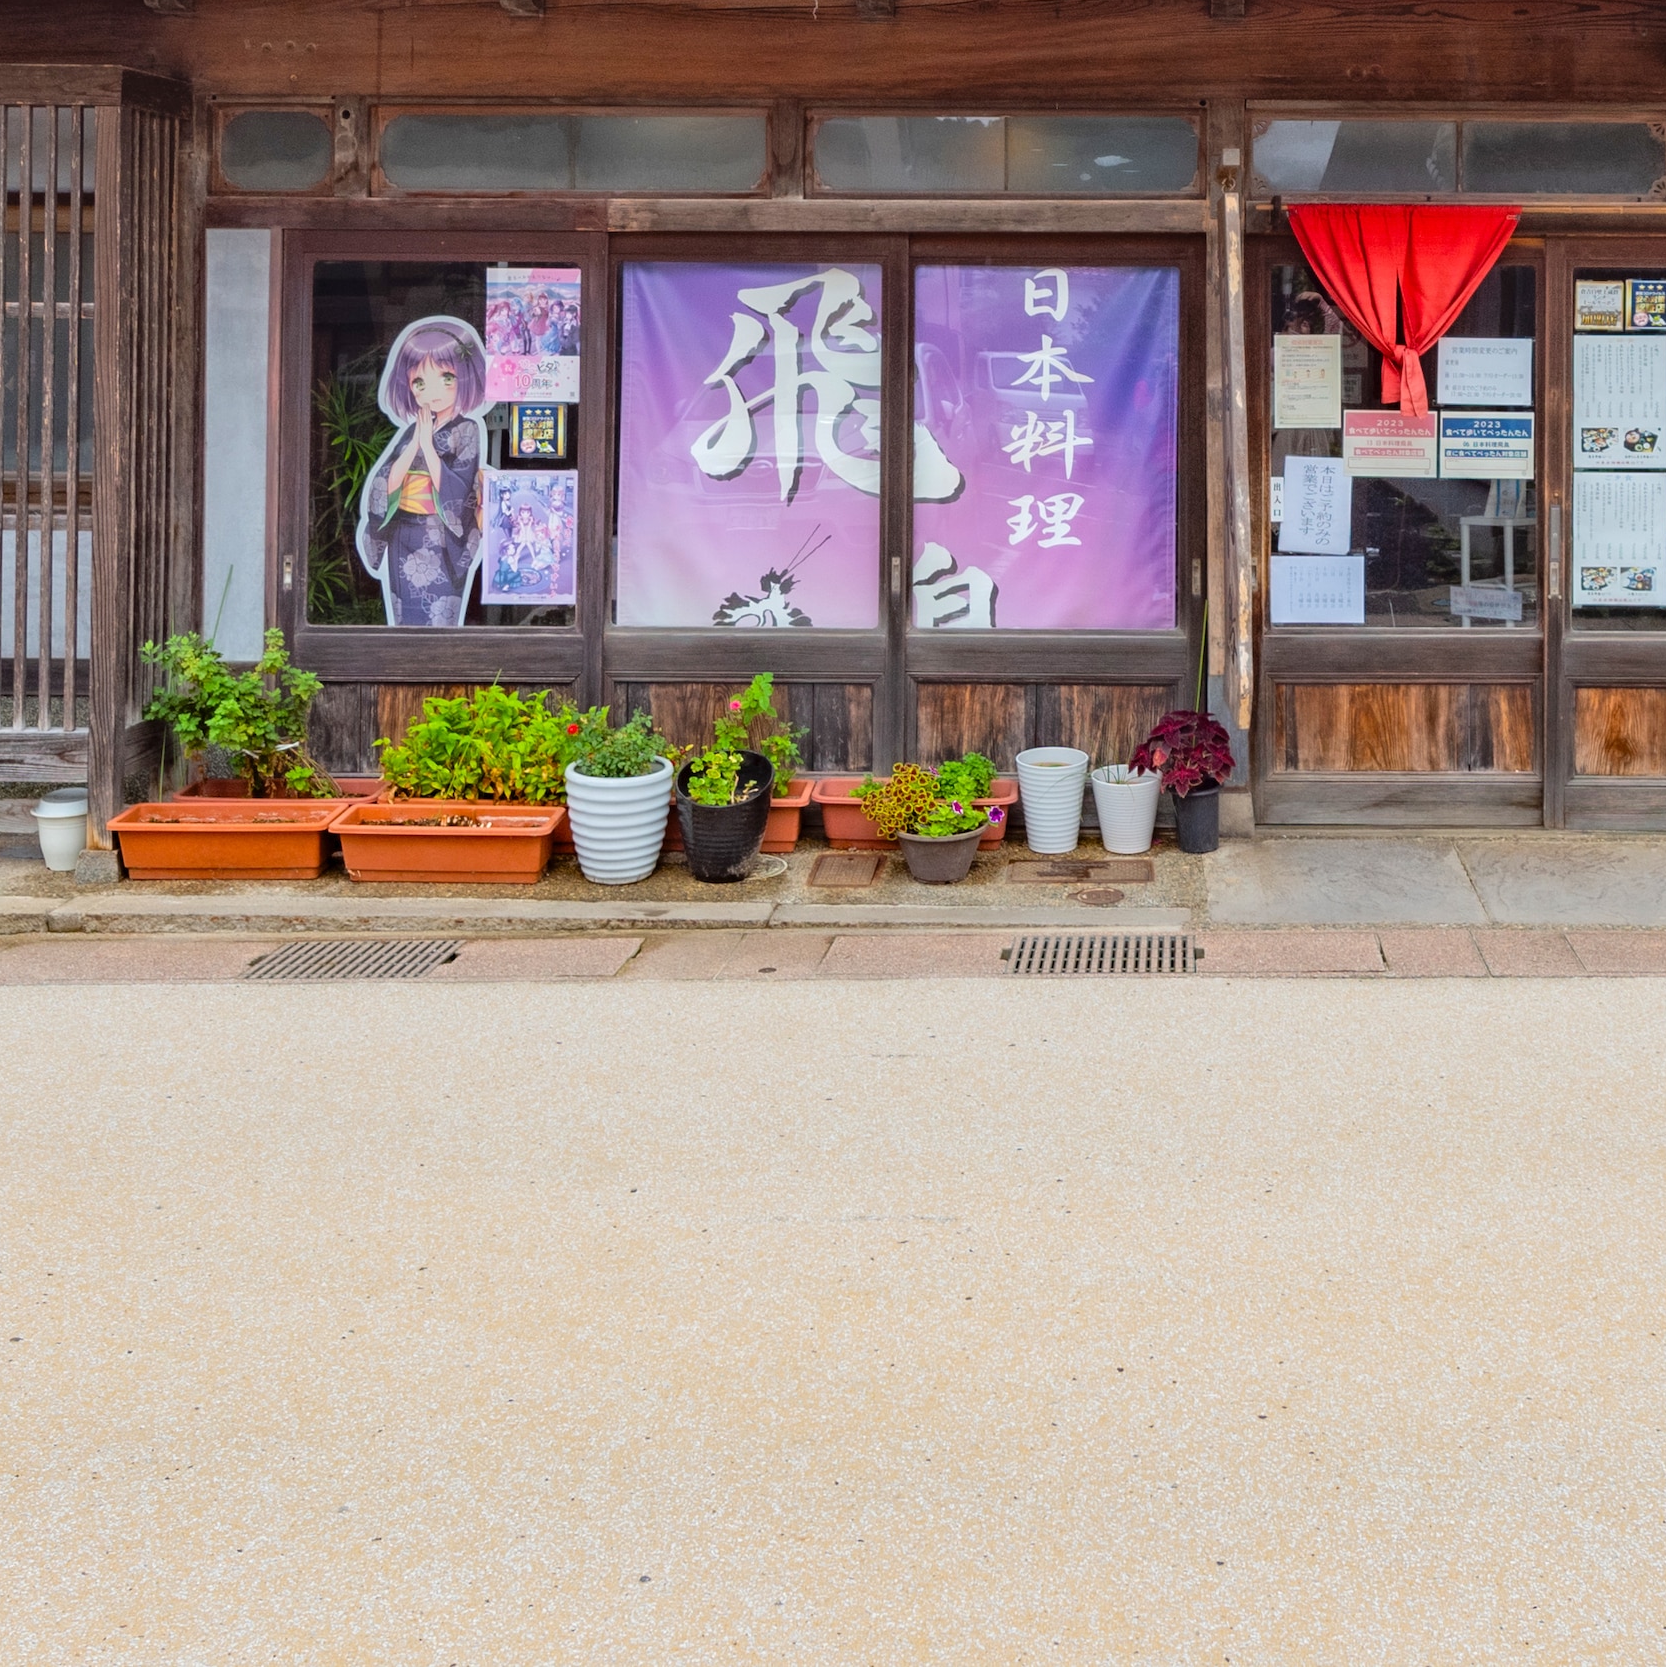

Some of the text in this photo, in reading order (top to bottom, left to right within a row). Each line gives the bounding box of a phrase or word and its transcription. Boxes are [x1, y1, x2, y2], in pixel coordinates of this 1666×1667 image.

[514, 374, 553, 390] 10周年
[1002, 267, 1094, 548] 日本料理
[1376, 419, 1404, 427] 2023
[1473, 420, 1502, 428] 2023
[1273, 482, 1282, 517] 出入口
[1299, 464, 1318, 535] 営業でございます
[1315, 465, 1336, 546] 本日はご予約のみの
